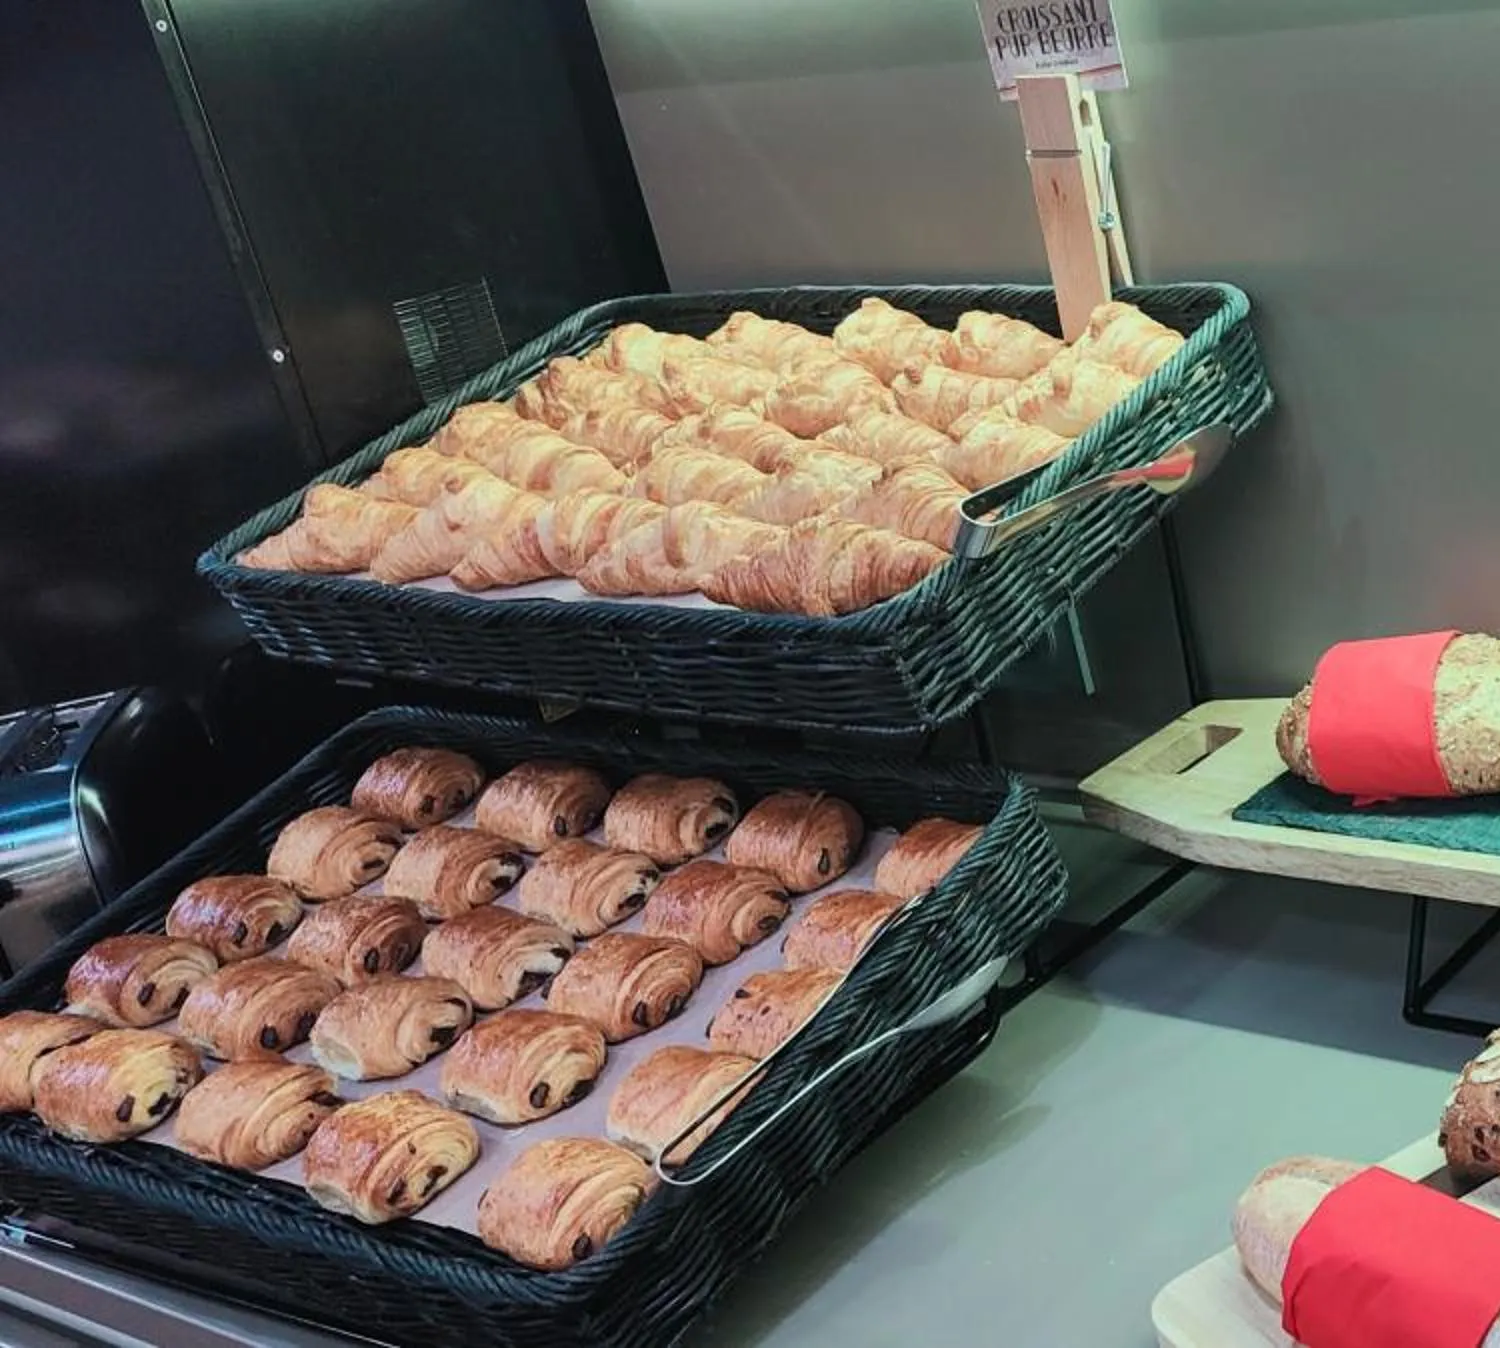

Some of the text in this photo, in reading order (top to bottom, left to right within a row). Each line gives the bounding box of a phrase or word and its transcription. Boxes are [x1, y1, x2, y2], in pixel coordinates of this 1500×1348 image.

[997, 0, 1100, 33] CROISSANT
[994, 23, 1114, 60] PUR BEURRE
